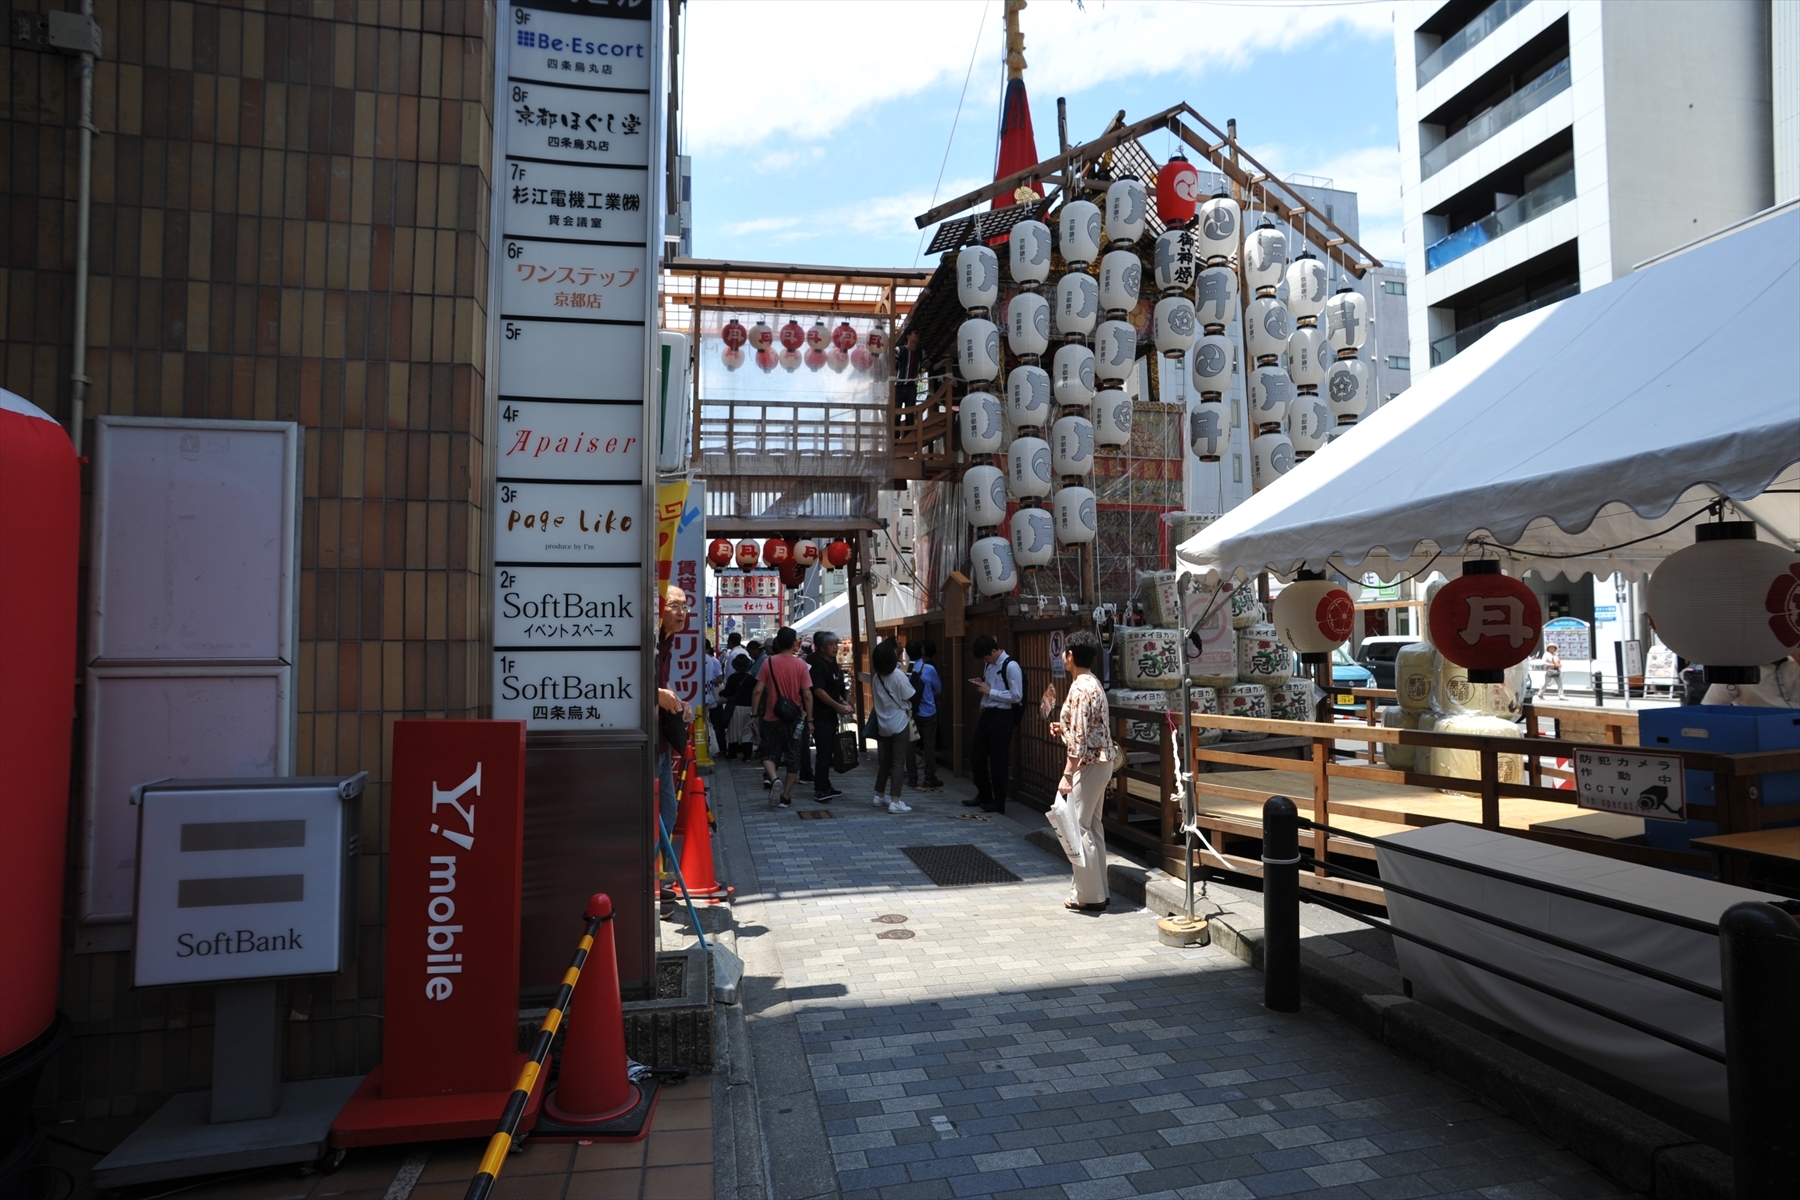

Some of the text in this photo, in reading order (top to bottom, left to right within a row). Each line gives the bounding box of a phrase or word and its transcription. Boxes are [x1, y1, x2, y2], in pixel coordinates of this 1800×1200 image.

[515, 9, 531, 26] 9F
[547, 58, 613, 75] 四条烏丸店
[512, 86, 529, 103] 8F
[515, 105, 642, 135] 京都ほぐし堂
[547, 136, 610, 152] 四条烏丸店
[511, 164, 526, 181] 7F
[548, 214, 603, 229] 貸会議室
[508, 242, 523, 259] 6F
[1174, 232, 1194, 285] 御神燈
[517, 263, 640, 288] ワンステップ
[553, 291, 603, 309] 京都店
[505, 323, 521, 341] 5F
[502, 405, 519, 423] 4F
[506, 429, 636, 457] Apaiser
[501, 486, 517, 504] 3F
[545, 543, 572, 551] produce
[573, 543, 582, 551] by
[500, 570, 516, 589] 2F
[502, 592, 634, 619] SoftBank
[523, 623, 614, 638] イベントスペース
[500, 657, 515, 674] 1F
[502, 675, 633, 701] SoftBank
[1189, 689, 1214, 698] イヨカン
[533, 705, 601, 721] 四条烏丸
[1579, 754, 1671, 771] 防犯カメラ
[1580, 767, 1672, 785] 作動中
[1584, 783, 1629, 796] CCTV
[1586, 795, 1596, 805] in
[175, 928, 303, 959] SoftBank
